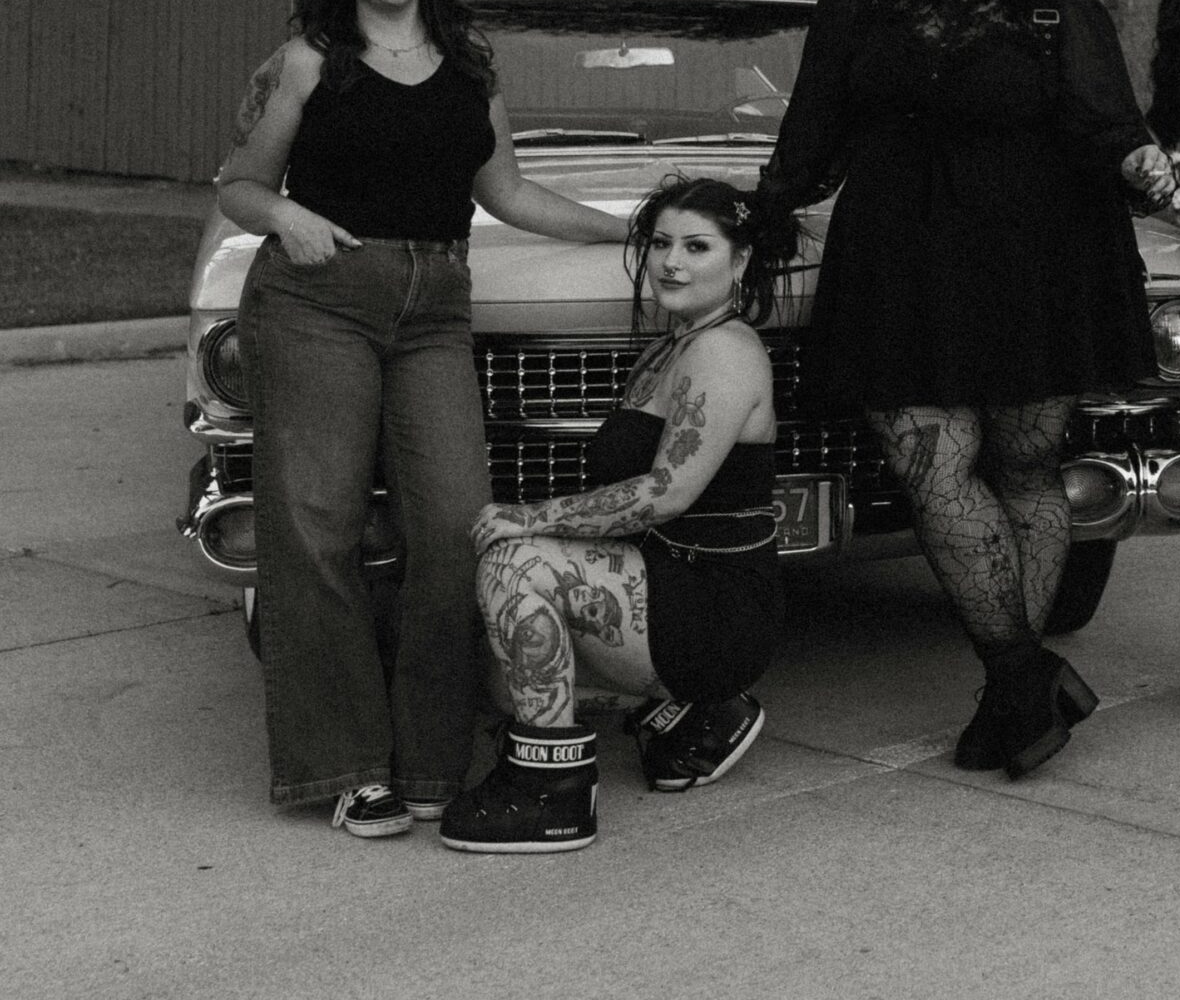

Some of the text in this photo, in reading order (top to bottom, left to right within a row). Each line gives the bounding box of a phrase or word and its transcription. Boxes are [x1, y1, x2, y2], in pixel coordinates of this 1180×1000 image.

[650, 702, 681, 730] MOON
[515, 742, 585, 762] MOON BOOT
